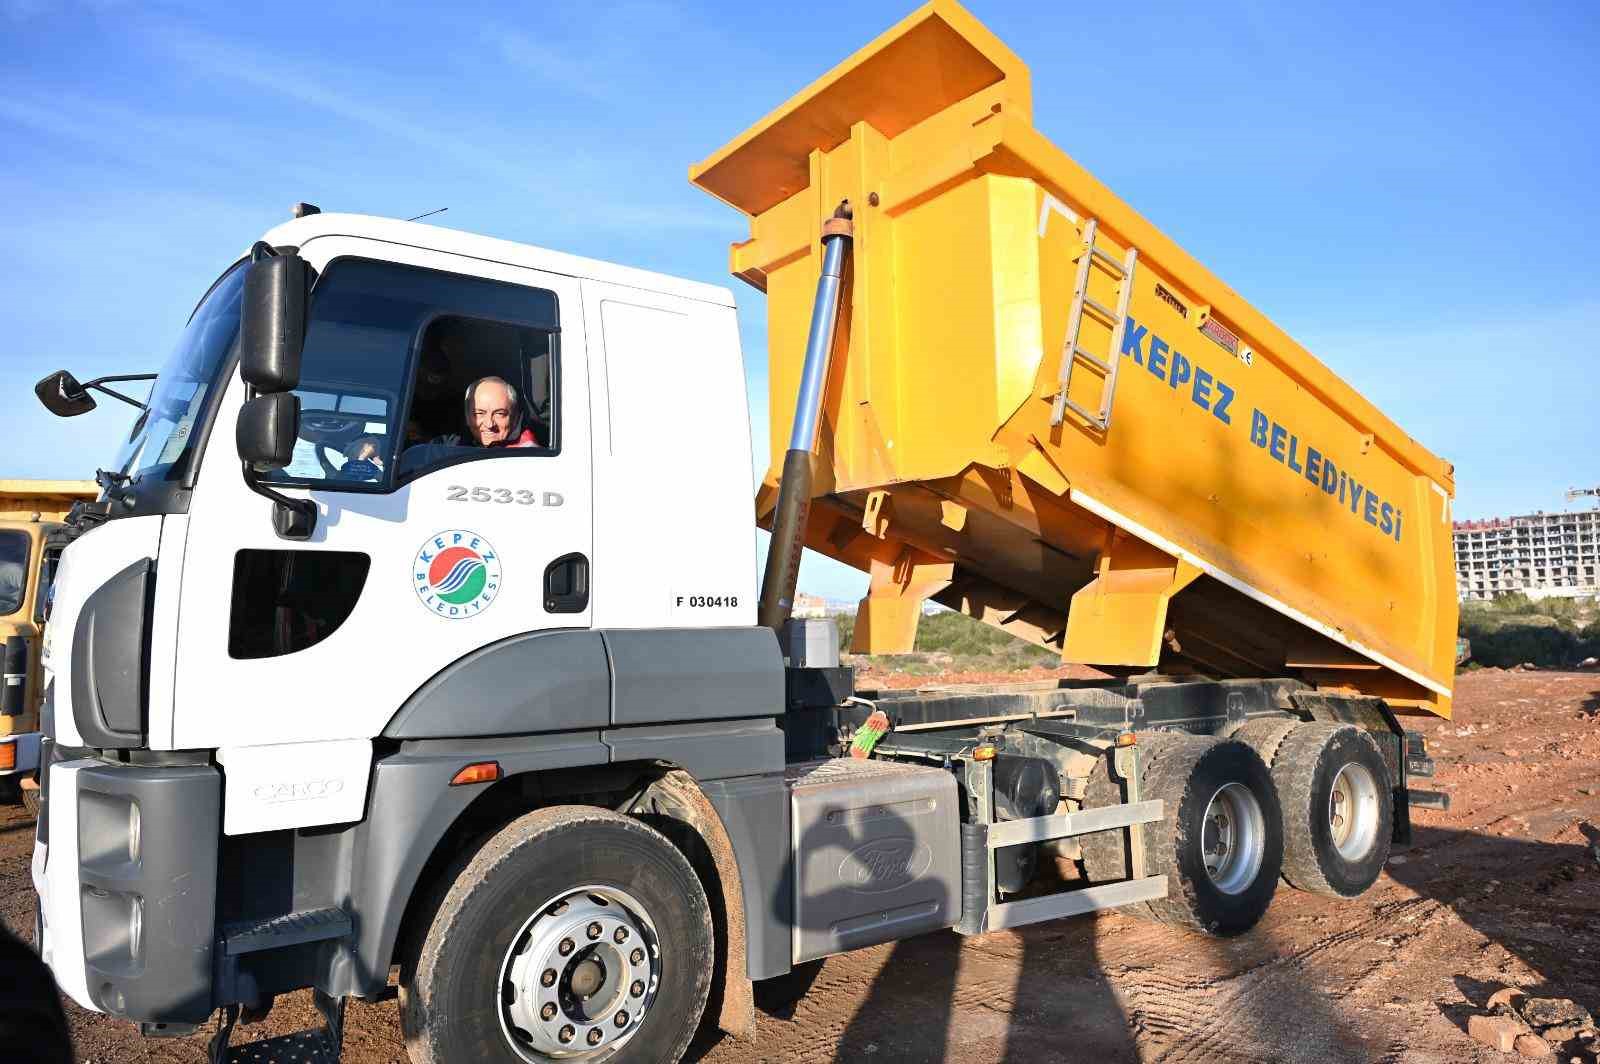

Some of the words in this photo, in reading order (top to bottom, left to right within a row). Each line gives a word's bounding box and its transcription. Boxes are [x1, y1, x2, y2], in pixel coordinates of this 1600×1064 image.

[1121, 315, 1236, 426] KEPEZ
[446, 486, 536, 506] 2533
[542, 491, 565, 507] D
[420, 533, 495, 564] KEPEZ
[676, 596, 685, 607] F
[689, 596, 738, 608] 030418
